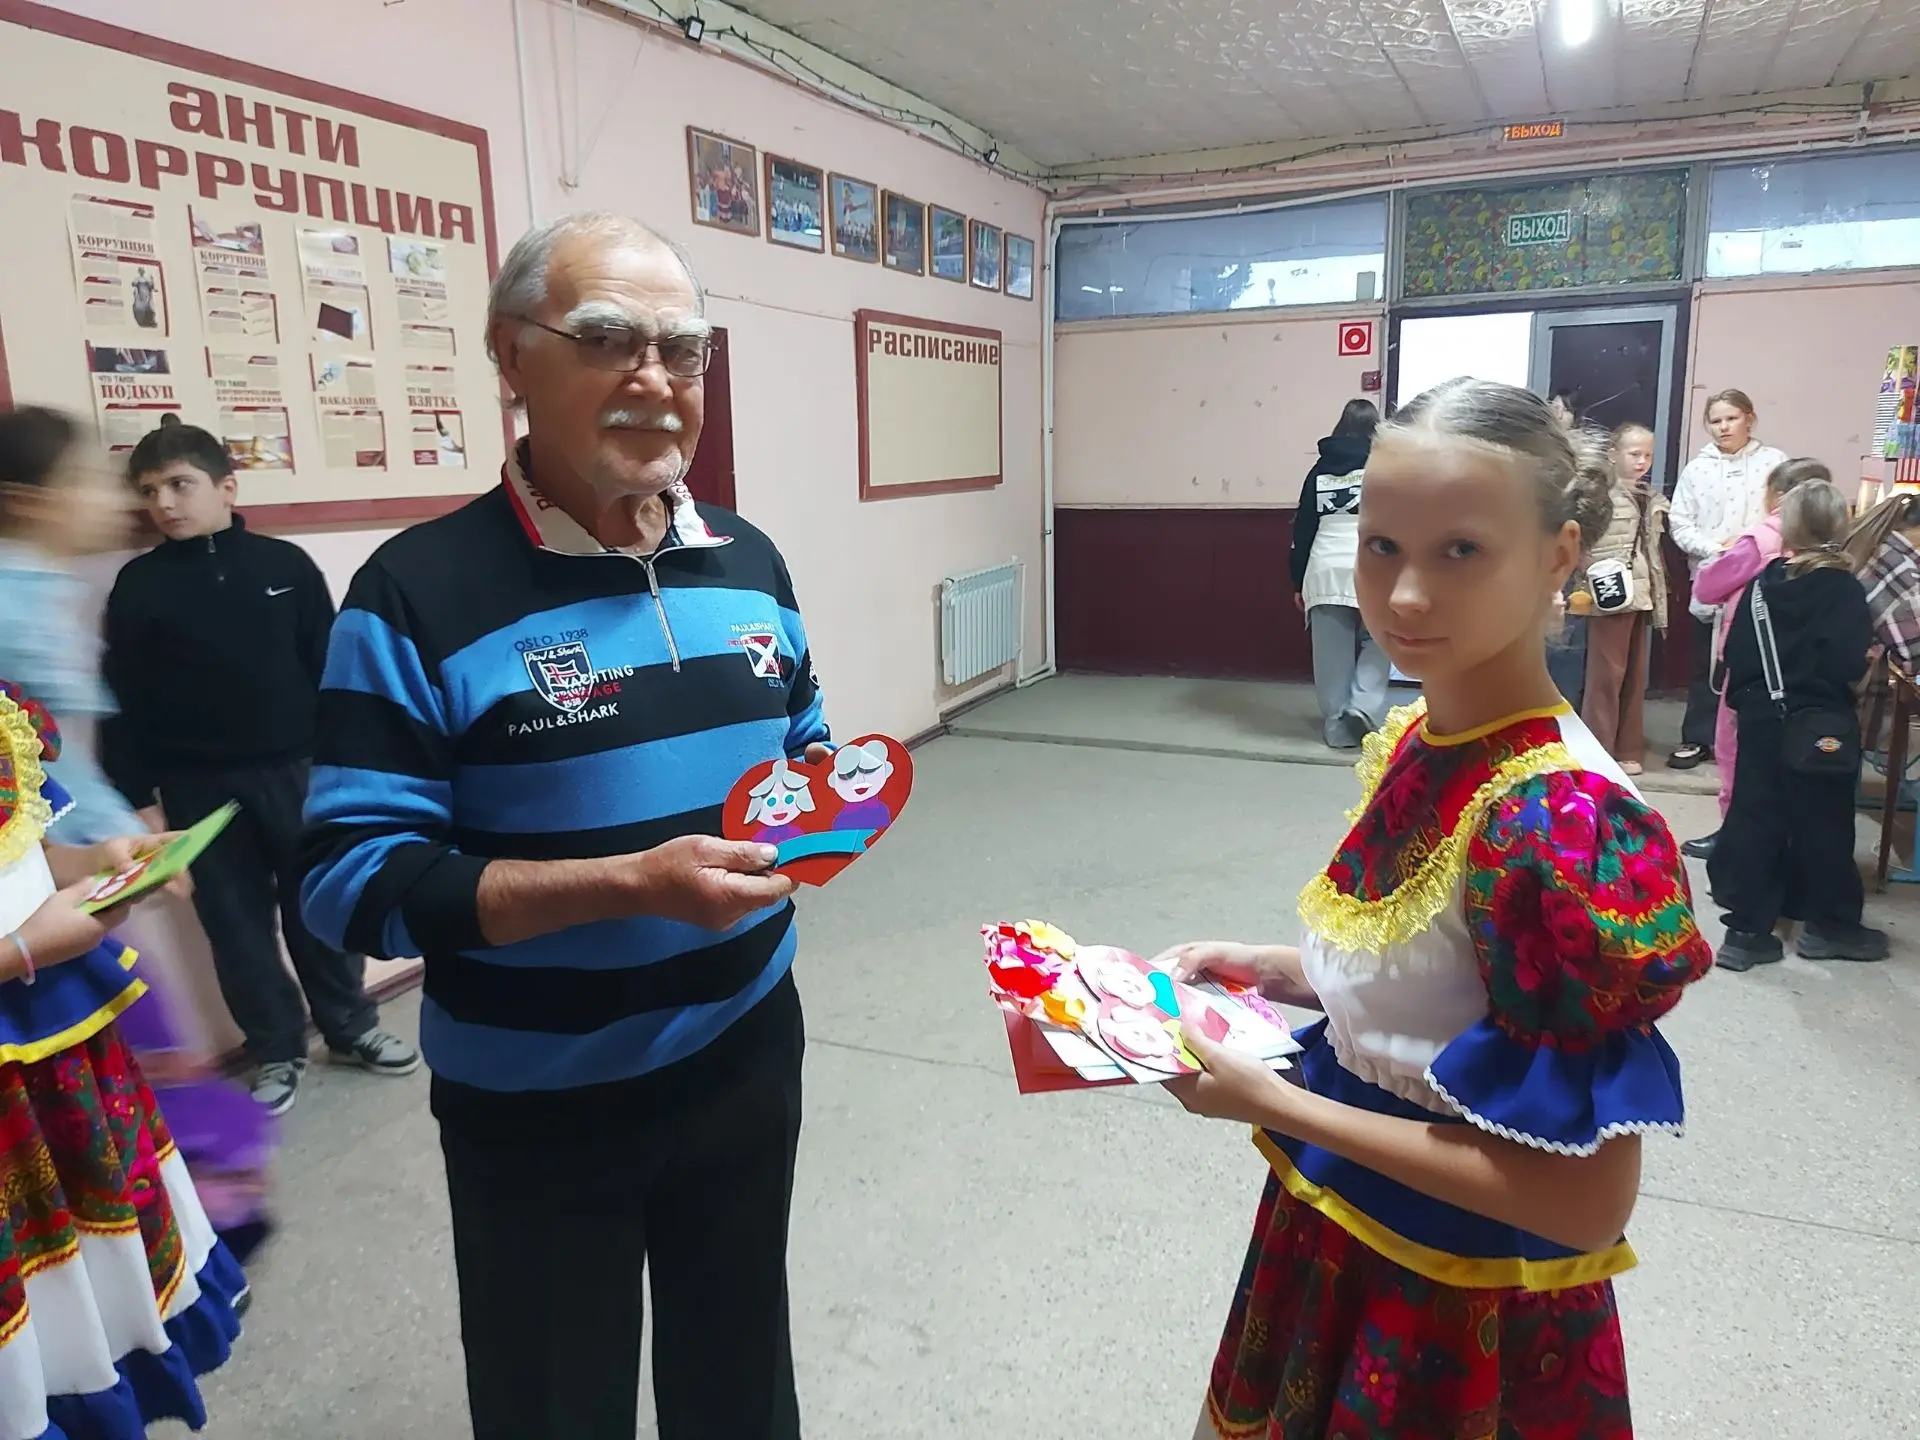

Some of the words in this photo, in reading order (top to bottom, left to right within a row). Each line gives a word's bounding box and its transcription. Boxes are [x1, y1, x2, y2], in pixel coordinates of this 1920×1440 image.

[1511, 122, 1561, 139] ВЫХОД
[1511, 215, 1567, 240] ВЫХОД
[77, 234, 155, 254] КОРРУПЦИЯ
[101, 384, 174, 399] ПОДКУП
[408, 395, 457, 408] ВЗЯТКА
[514, 635, 553, 652] OSLO
[560, 628, 589, 643] 1938
[561, 664, 634, 690] YACHTING
[508, 702, 620, 738] PAUL&SHARK
